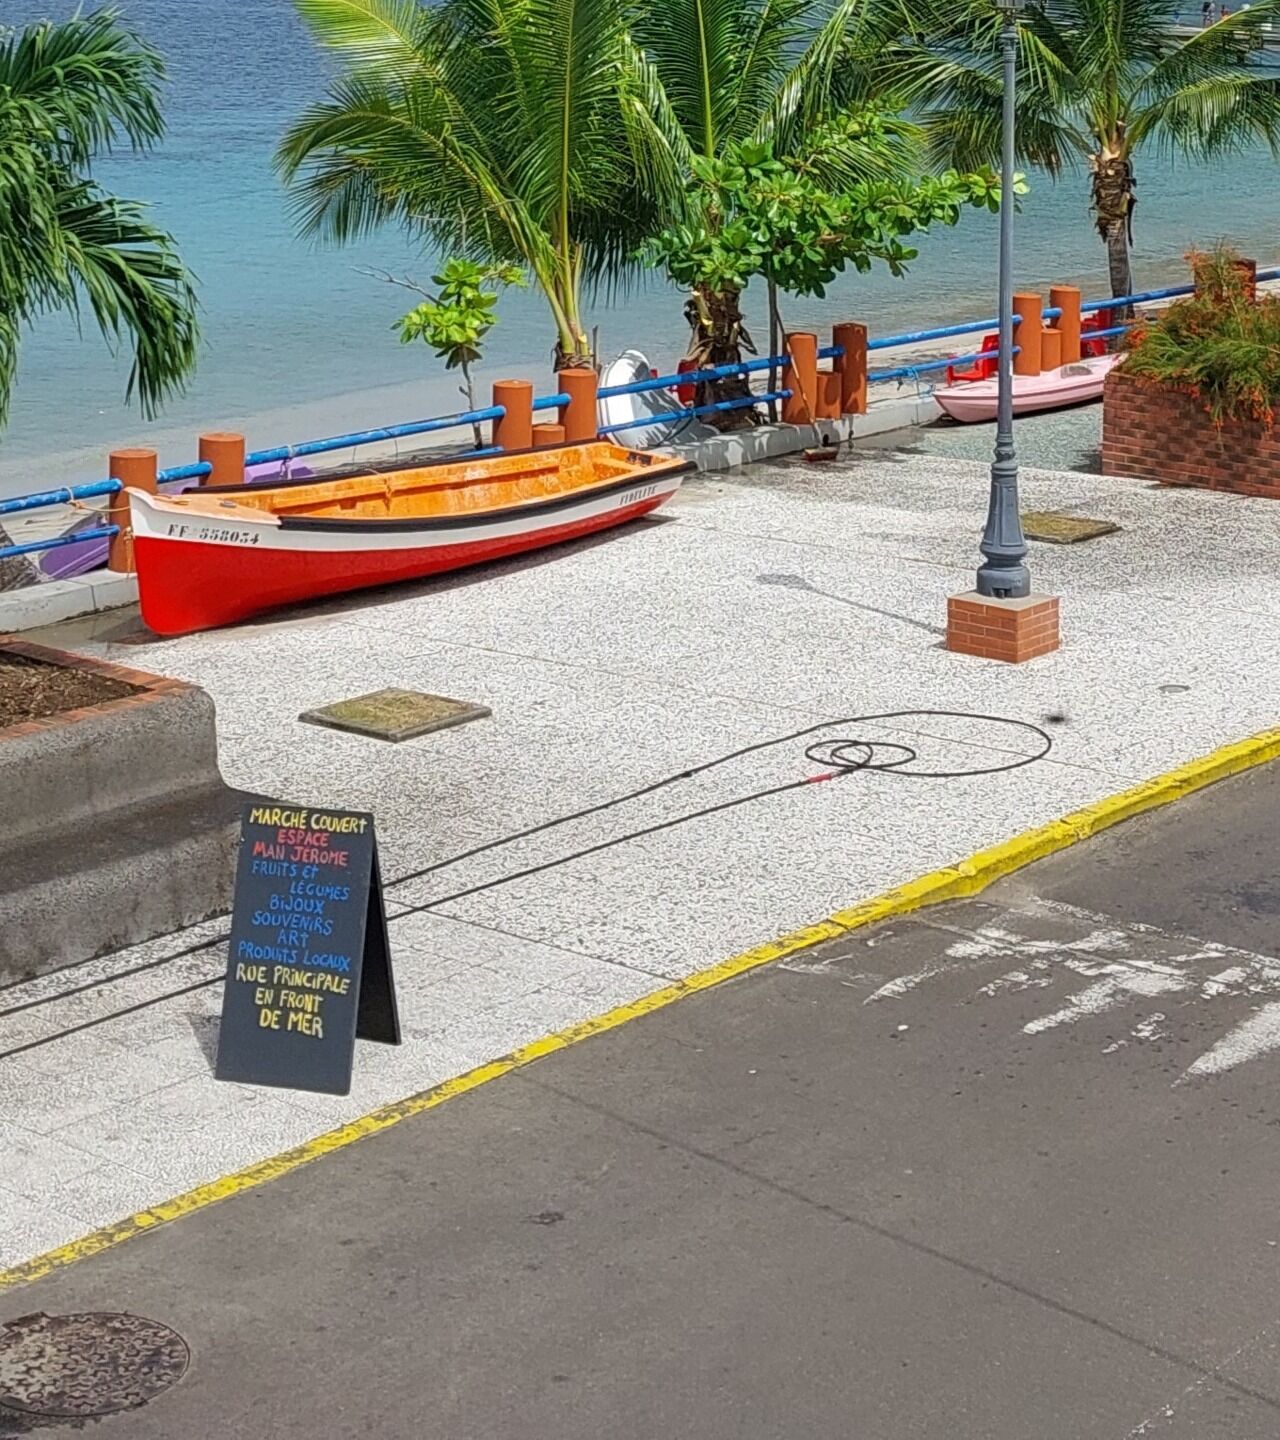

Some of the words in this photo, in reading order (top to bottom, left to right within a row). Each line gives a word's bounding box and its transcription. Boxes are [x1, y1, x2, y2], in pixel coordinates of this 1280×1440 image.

[249, 808, 308, 829] MARCHÉ
[277, 829, 330, 847] ESPACE
[252, 841, 286, 859] MAN
[252, 860, 297, 877] FRUITS
[290, 880, 350, 900] LÉGUMES
[251, 910, 334, 936] SOUVENIRS
[238, 940, 298, 964] PRODUITS
[303, 951, 352, 972] LOCAUX
[235, 962, 267, 983] RUE
[273, 965, 351, 995] PRINCIPALE
[254, 987, 274, 1005] EN
[279, 990, 324, 1013] FRONT
[259, 1008, 282, 1030] DE
[287, 1012, 324, 1039] MER
